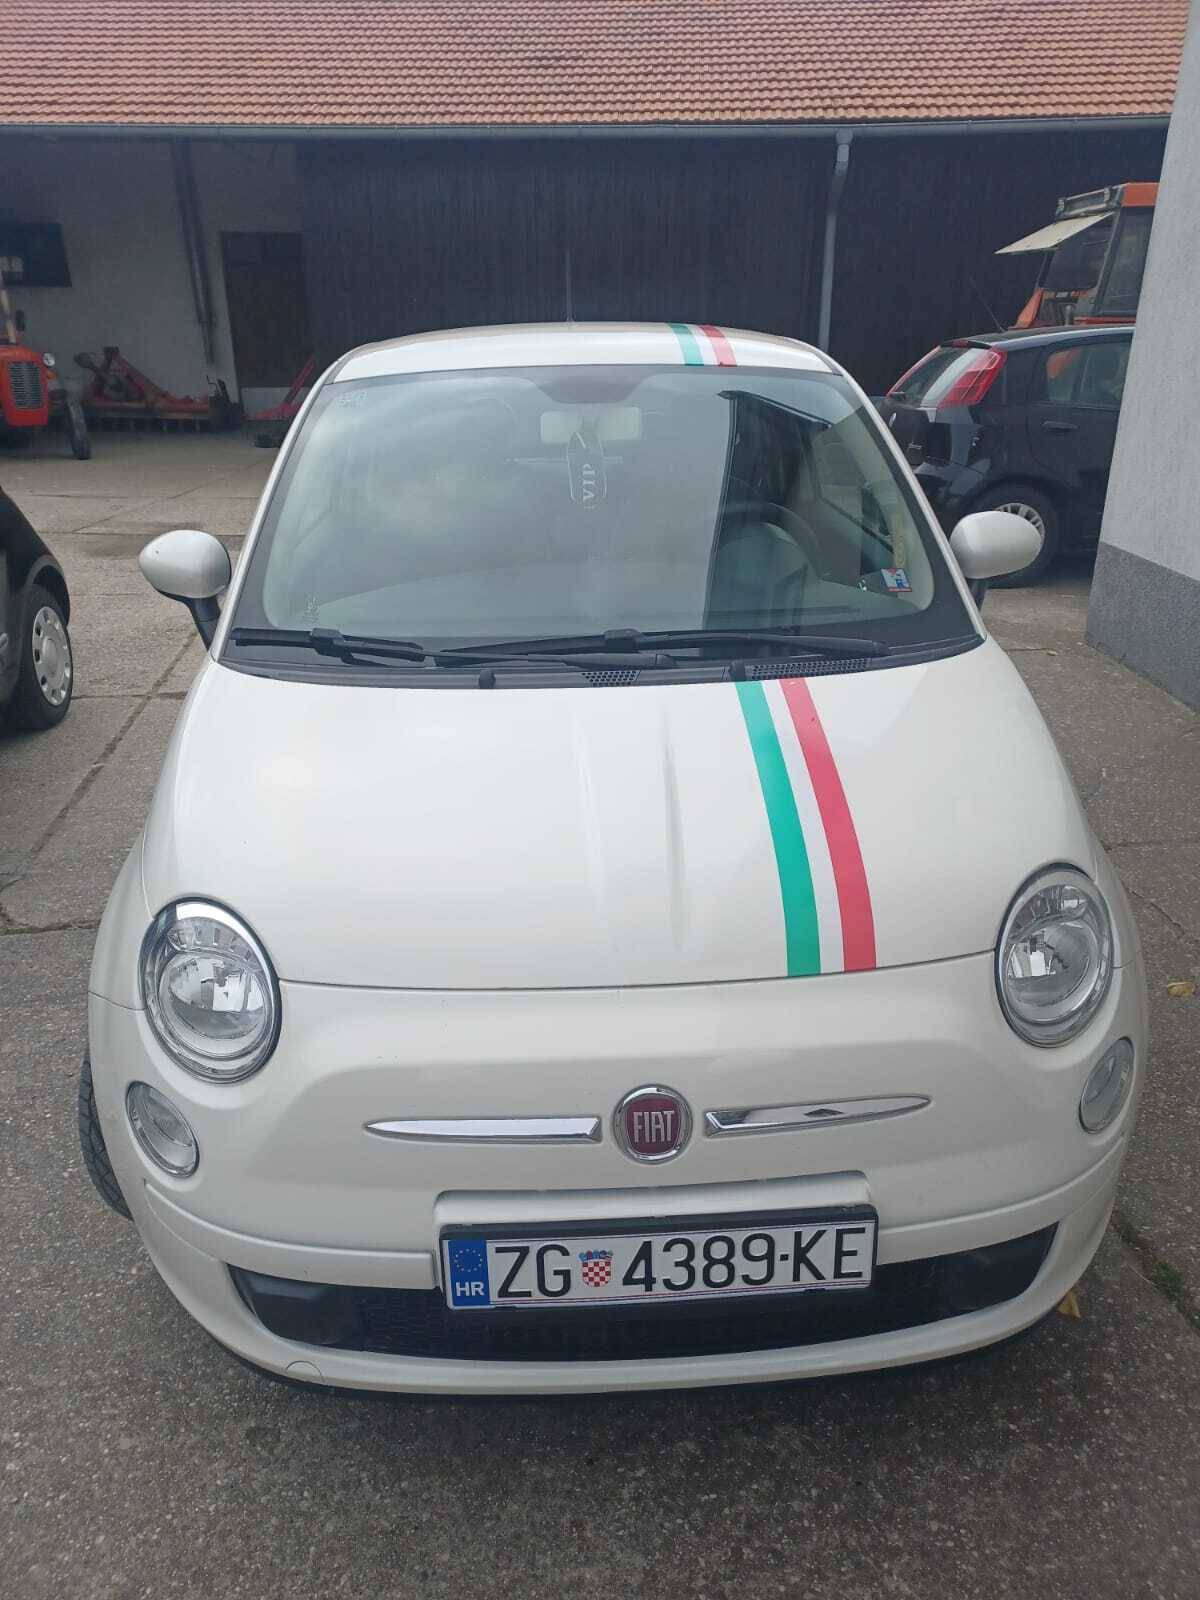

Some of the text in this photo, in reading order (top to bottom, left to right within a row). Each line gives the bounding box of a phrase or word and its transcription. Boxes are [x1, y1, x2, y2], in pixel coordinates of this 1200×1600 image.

[632, 1110, 675, 1143] FIAT
[494, 1243, 572, 1298] ZG
[455, 1281, 485, 1297] HR
